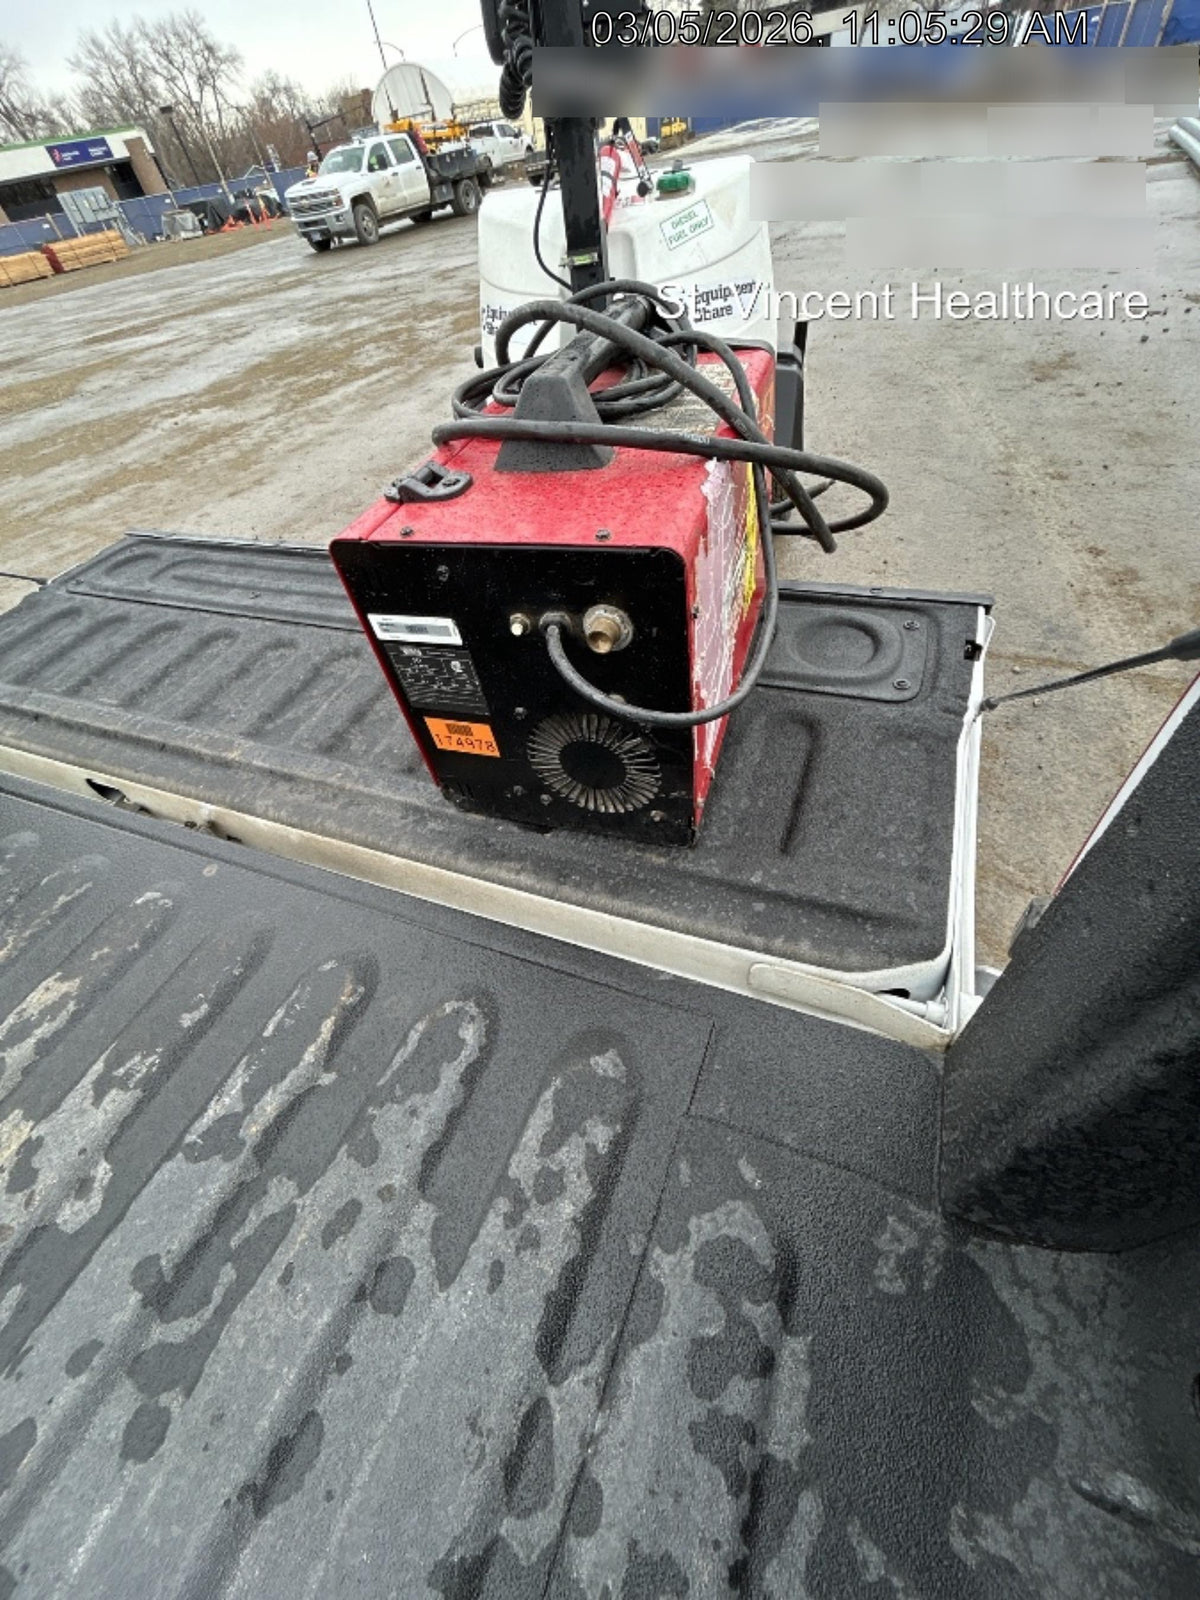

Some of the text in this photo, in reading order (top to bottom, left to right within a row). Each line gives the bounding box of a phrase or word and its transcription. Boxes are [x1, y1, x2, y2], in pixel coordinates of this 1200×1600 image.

[668, 215, 709, 245] FUEL ONLY
[671, 210, 699, 230] DIESEL
[434, 733, 496, 752] 174978
